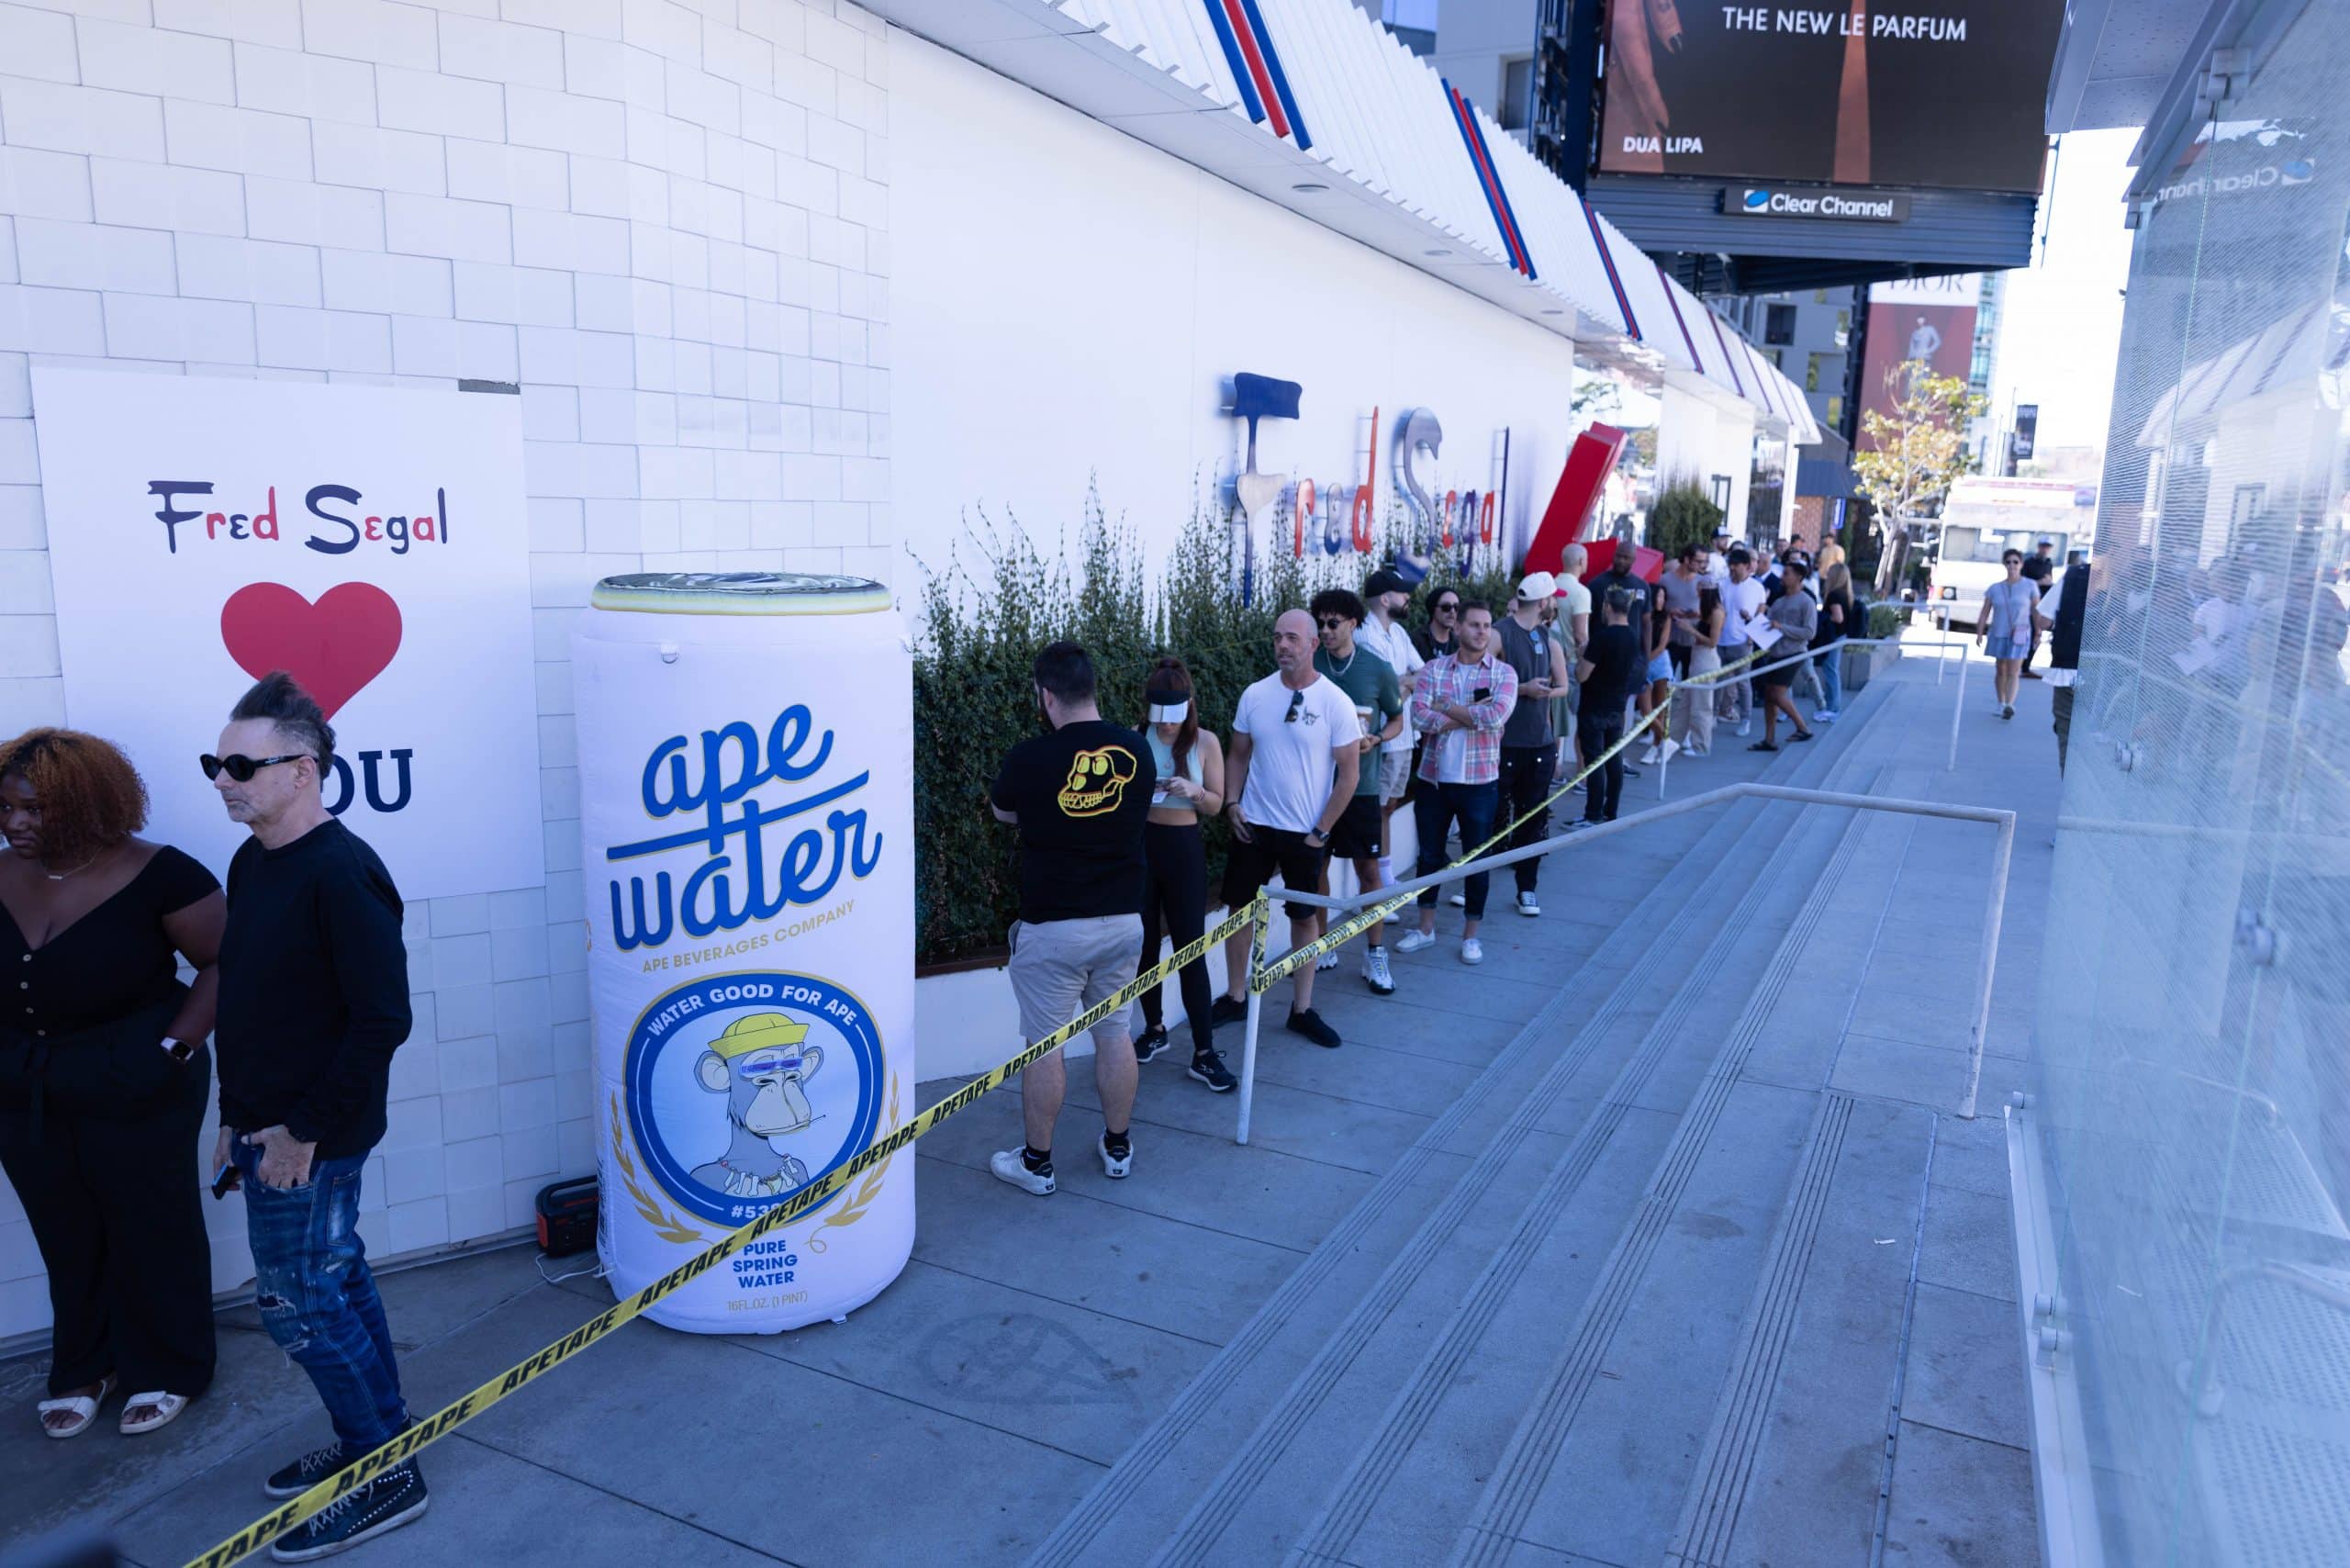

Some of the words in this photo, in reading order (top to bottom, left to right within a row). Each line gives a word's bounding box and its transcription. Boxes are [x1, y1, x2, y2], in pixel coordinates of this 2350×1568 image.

[1722, 7, 1768, 31] THE
[1775, 10, 1833, 35] NEW
[1841, 13, 1864, 36] LE
[1873, 15, 1967, 41] PARFUM
[1623, 136, 1661, 153] DUA
[1665, 138, 1704, 154] LIPA
[1771, 194, 1818, 215] Clear
[1820, 196, 1893, 218] Channel
[147, 480, 280, 554] Fred
[304, 484, 448, 554] Segal
[1234, 372, 1379, 608] Fred
[1394, 407, 1510, 583] Segal
[319, 748, 414, 815] OU
[642, 704, 834, 855] ape
[610, 799, 883, 951] water
[643, 957, 669, 973] APE
[673, 935, 769, 968] BEVERAGES
[774, 899, 856, 942] COMPANY
[647, 994, 706, 1037] WATER
[709, 983, 774, 1004] GOOD
[781, 985, 822, 1006] FOR
[823, 998, 857, 1026] APE
[191, 1502, 300, 1568] TAPE
[331, 1396, 476, 1500] APETAPE
[500, 1307, 619, 1395] APETAPE
[637, 1237, 736, 1310] APETAPE
[750, 1174, 832, 1240] APETAPE
[845, 1120, 919, 1176] APETAPE
[930, 1075, 991, 1126] APETAPE
[1002, 1035, 1058, 1083] APETAPE
[1068, 1000, 1111, 1039] APETAPE
[1119, 967, 1160, 1005] APETAPE
[1167, 937, 1205, 974] APETAPE
[1211, 911, 1244, 946] APETAPE
[733, 1254, 798, 1273] SPRING
[744, 1239, 787, 1257] PURE
[738, 1271, 794, 1289] WATER
